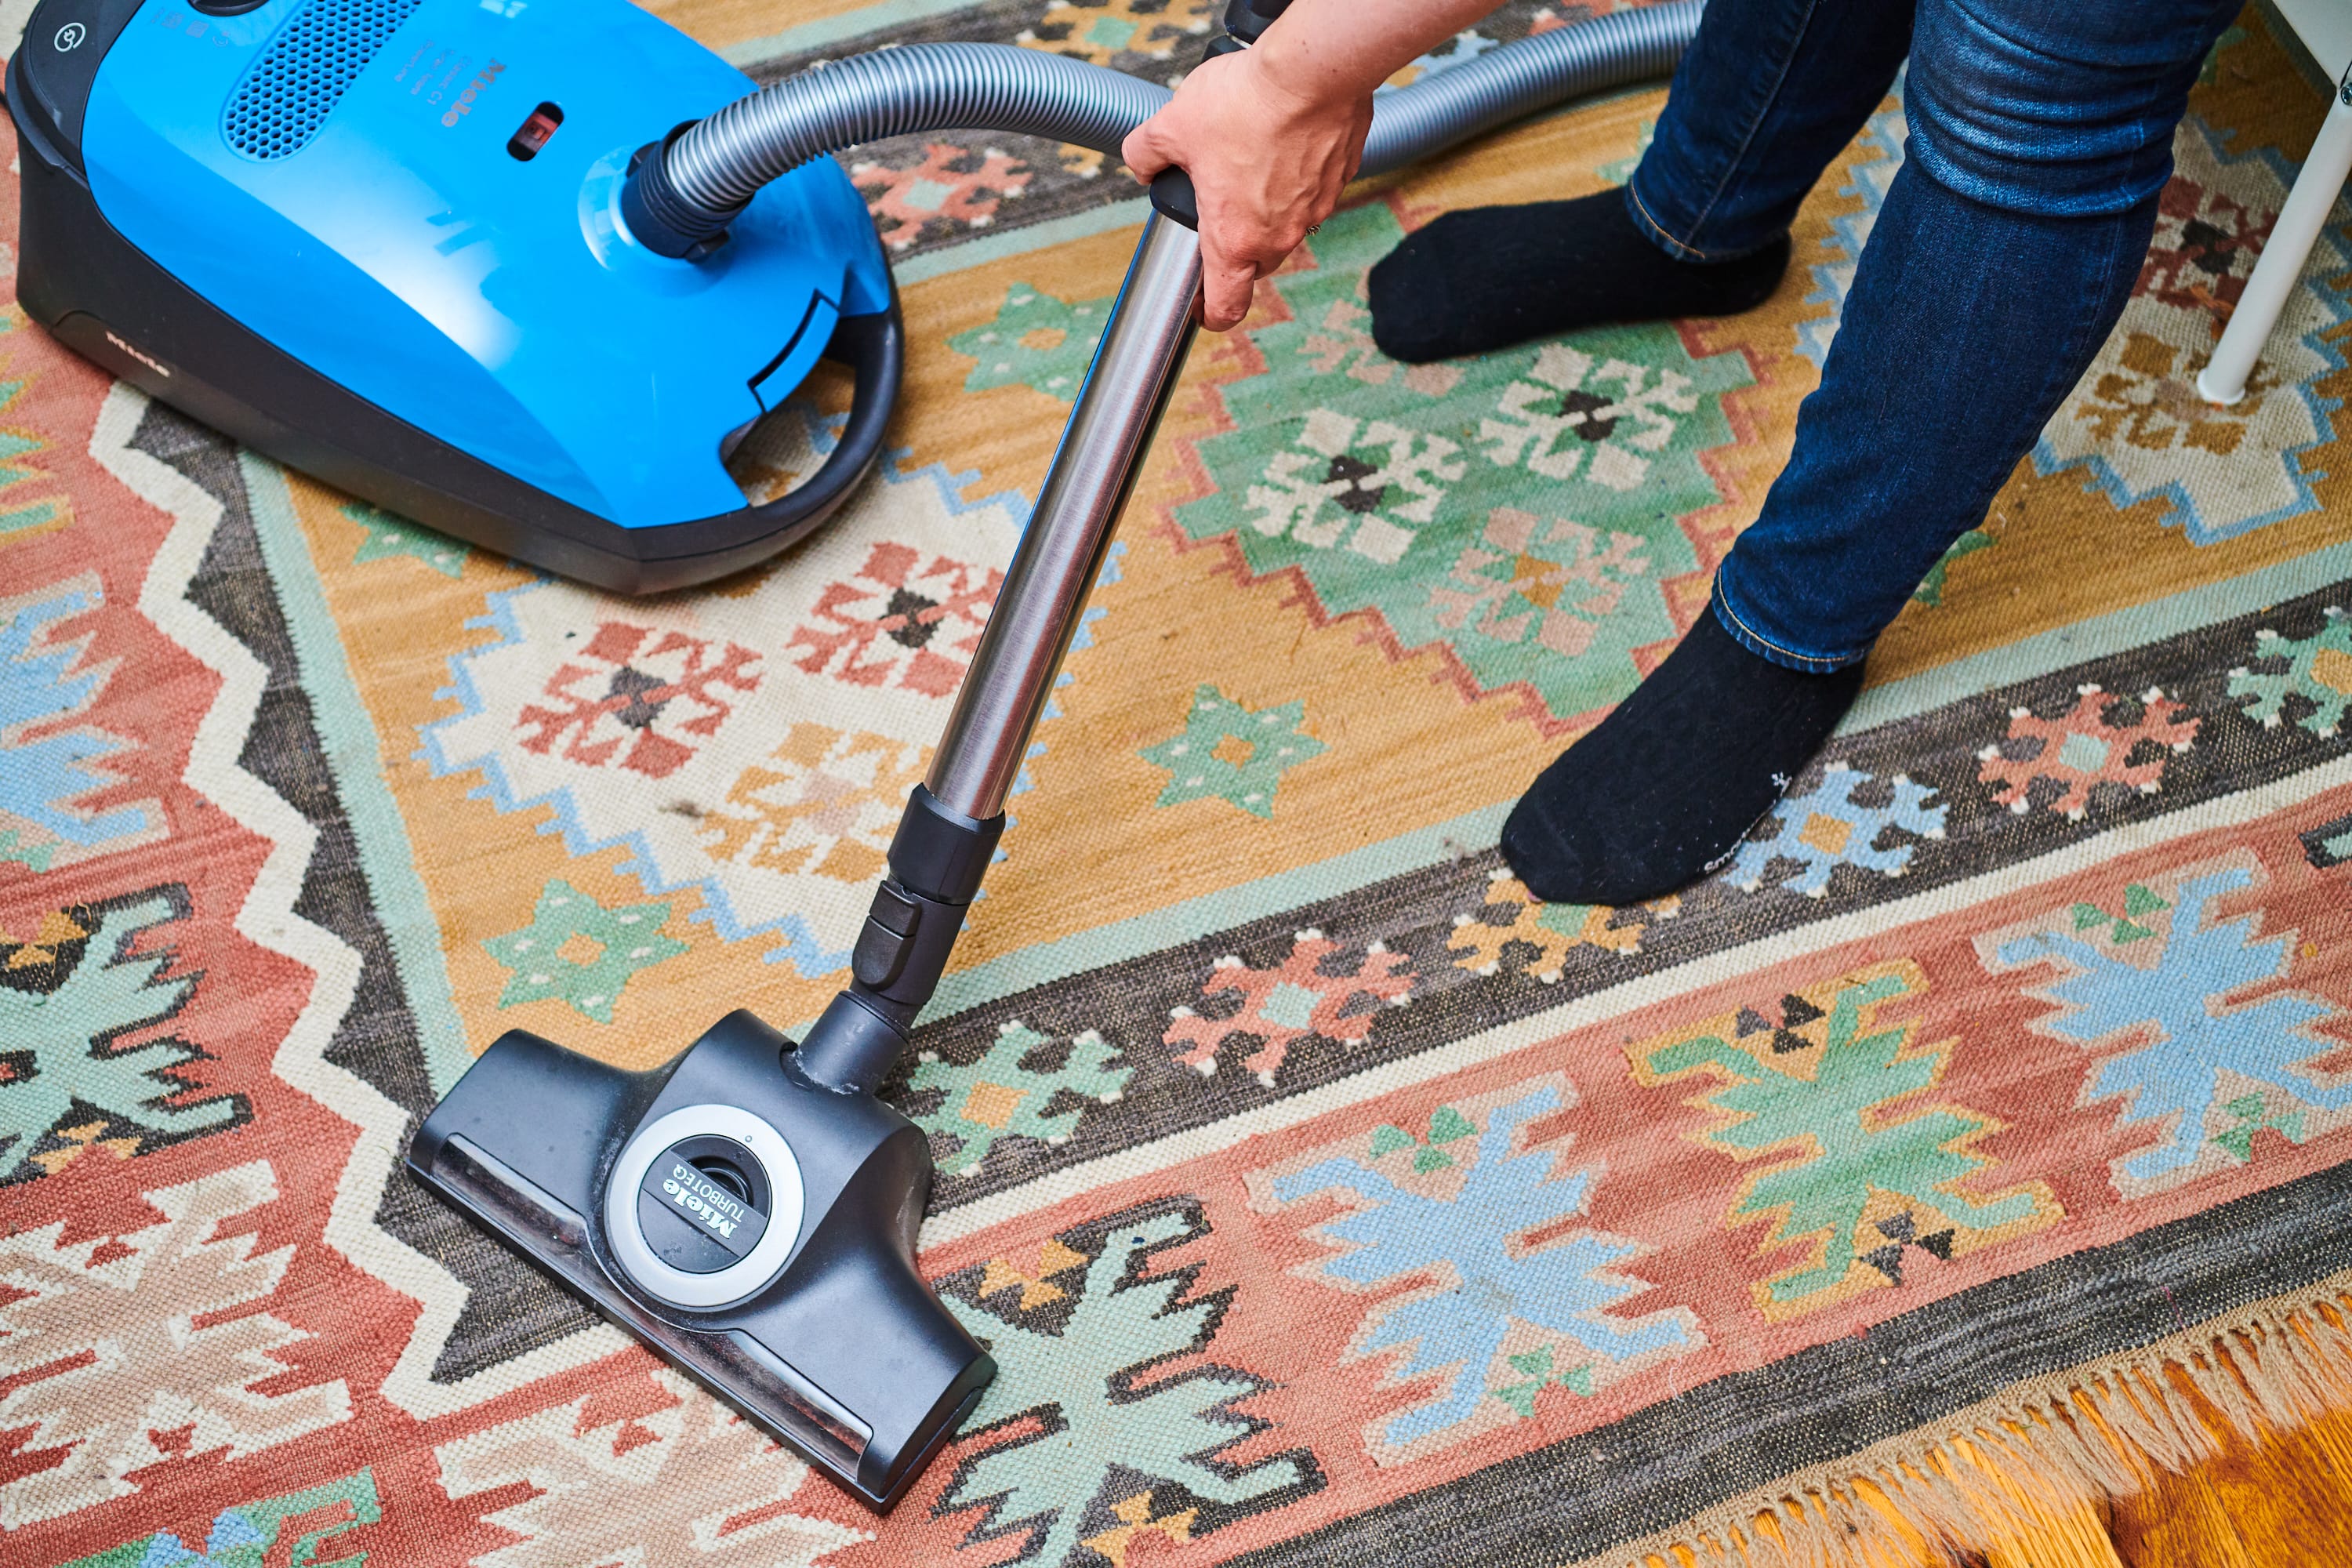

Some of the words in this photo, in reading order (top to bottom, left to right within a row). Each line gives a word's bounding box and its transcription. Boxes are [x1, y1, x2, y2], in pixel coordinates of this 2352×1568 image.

[441, 57, 507, 128] Miele
[105, 331, 171, 378] Miele
[662, 1178, 739, 1240] Miele
[673, 1163, 745, 1223] TURBOTEQ
